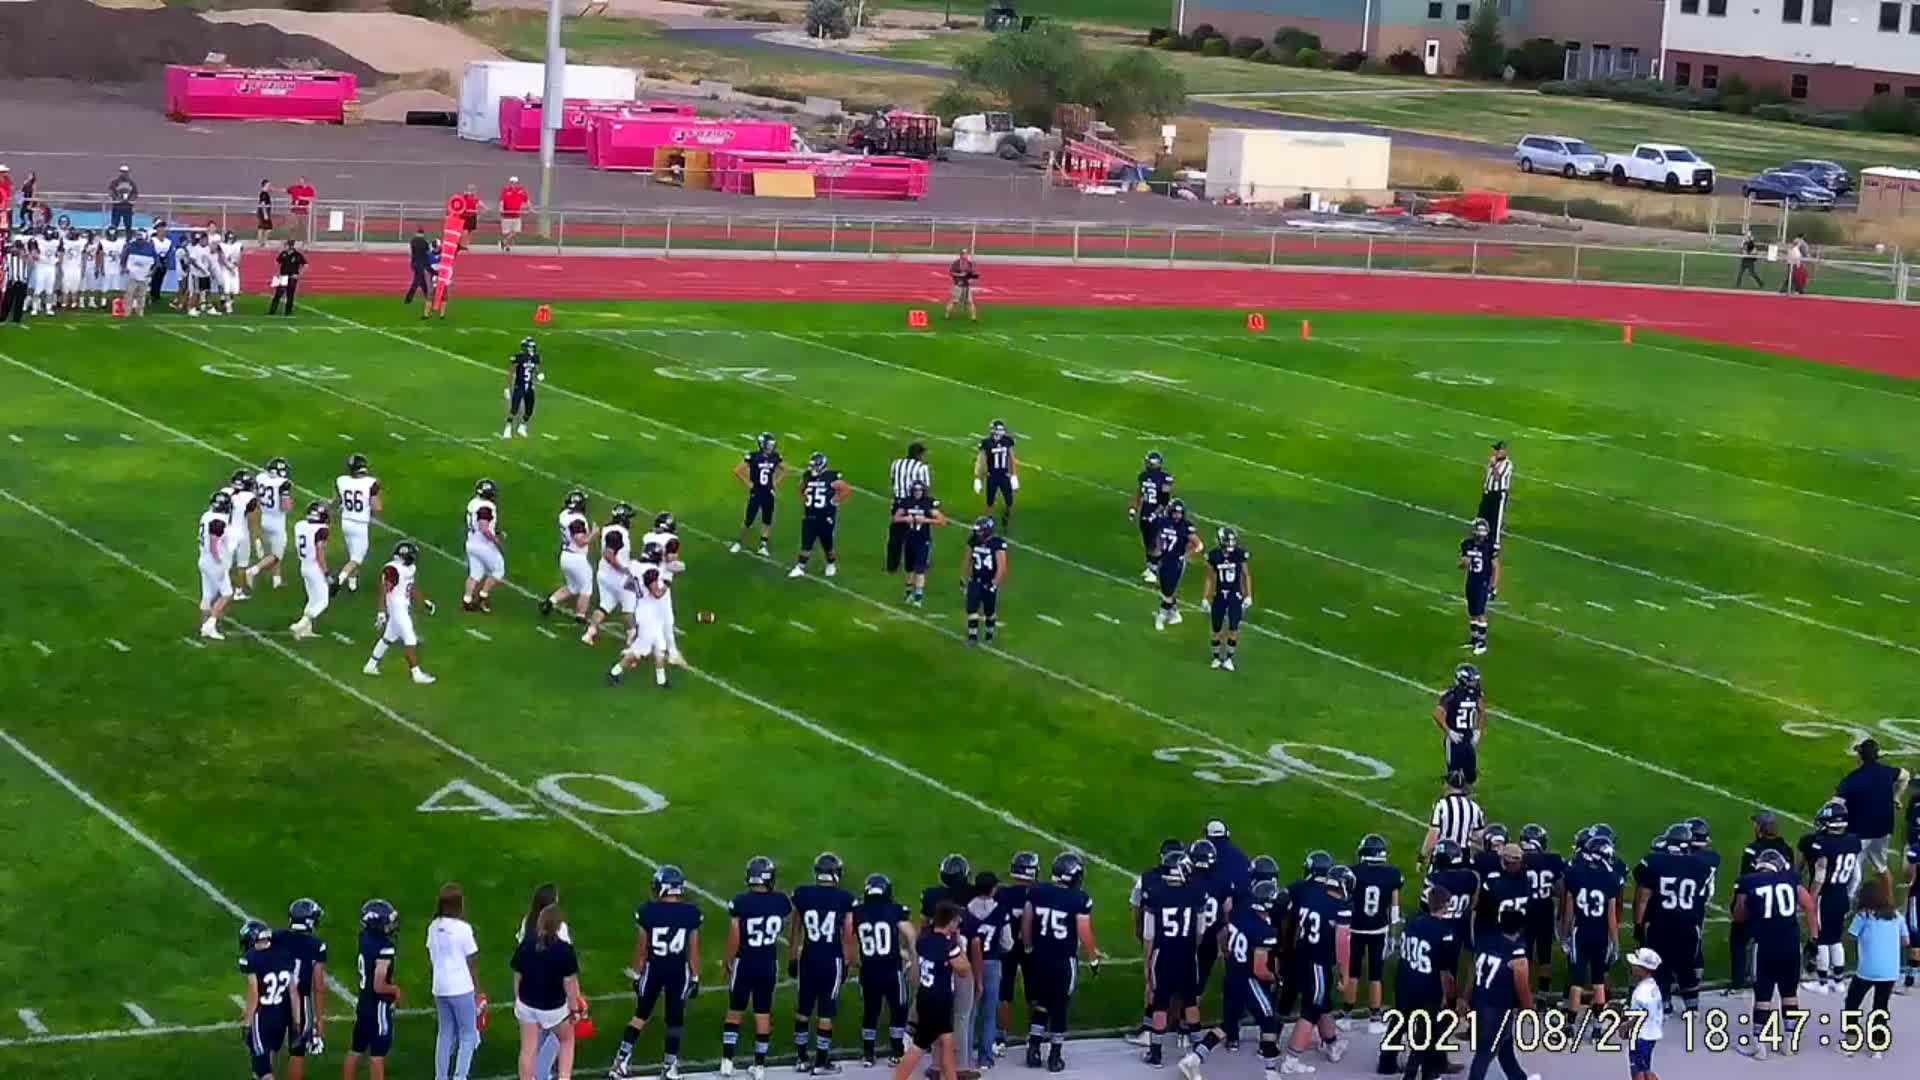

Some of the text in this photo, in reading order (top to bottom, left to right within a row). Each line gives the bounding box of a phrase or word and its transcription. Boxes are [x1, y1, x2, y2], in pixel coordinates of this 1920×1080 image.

[523, 367, 533, 382] 5
[759, 468, 770, 486] 6
[344, 489, 364, 512] 66
[1152, 743, 1394, 784] 30
[416, 772, 670, 820] 40
[1830, 853, 1857, 885] 18
[1364, 885, 1381, 916] 8
[1575, 887, 1605, 917] 43
[1659, 877, 1697, 910] 50
[1755, 883, 1795, 919] 70
[746, 915, 782, 947] 59
[803, 909, 837, 943] 84
[1035, 907, 1068, 940] 75
[1161, 907, 1191, 937] 51
[651, 926, 687, 957] 54
[858, 921, 891, 956] 60
[1475, 952, 1502, 989] 47
[260, 970, 290, 1005] 32
